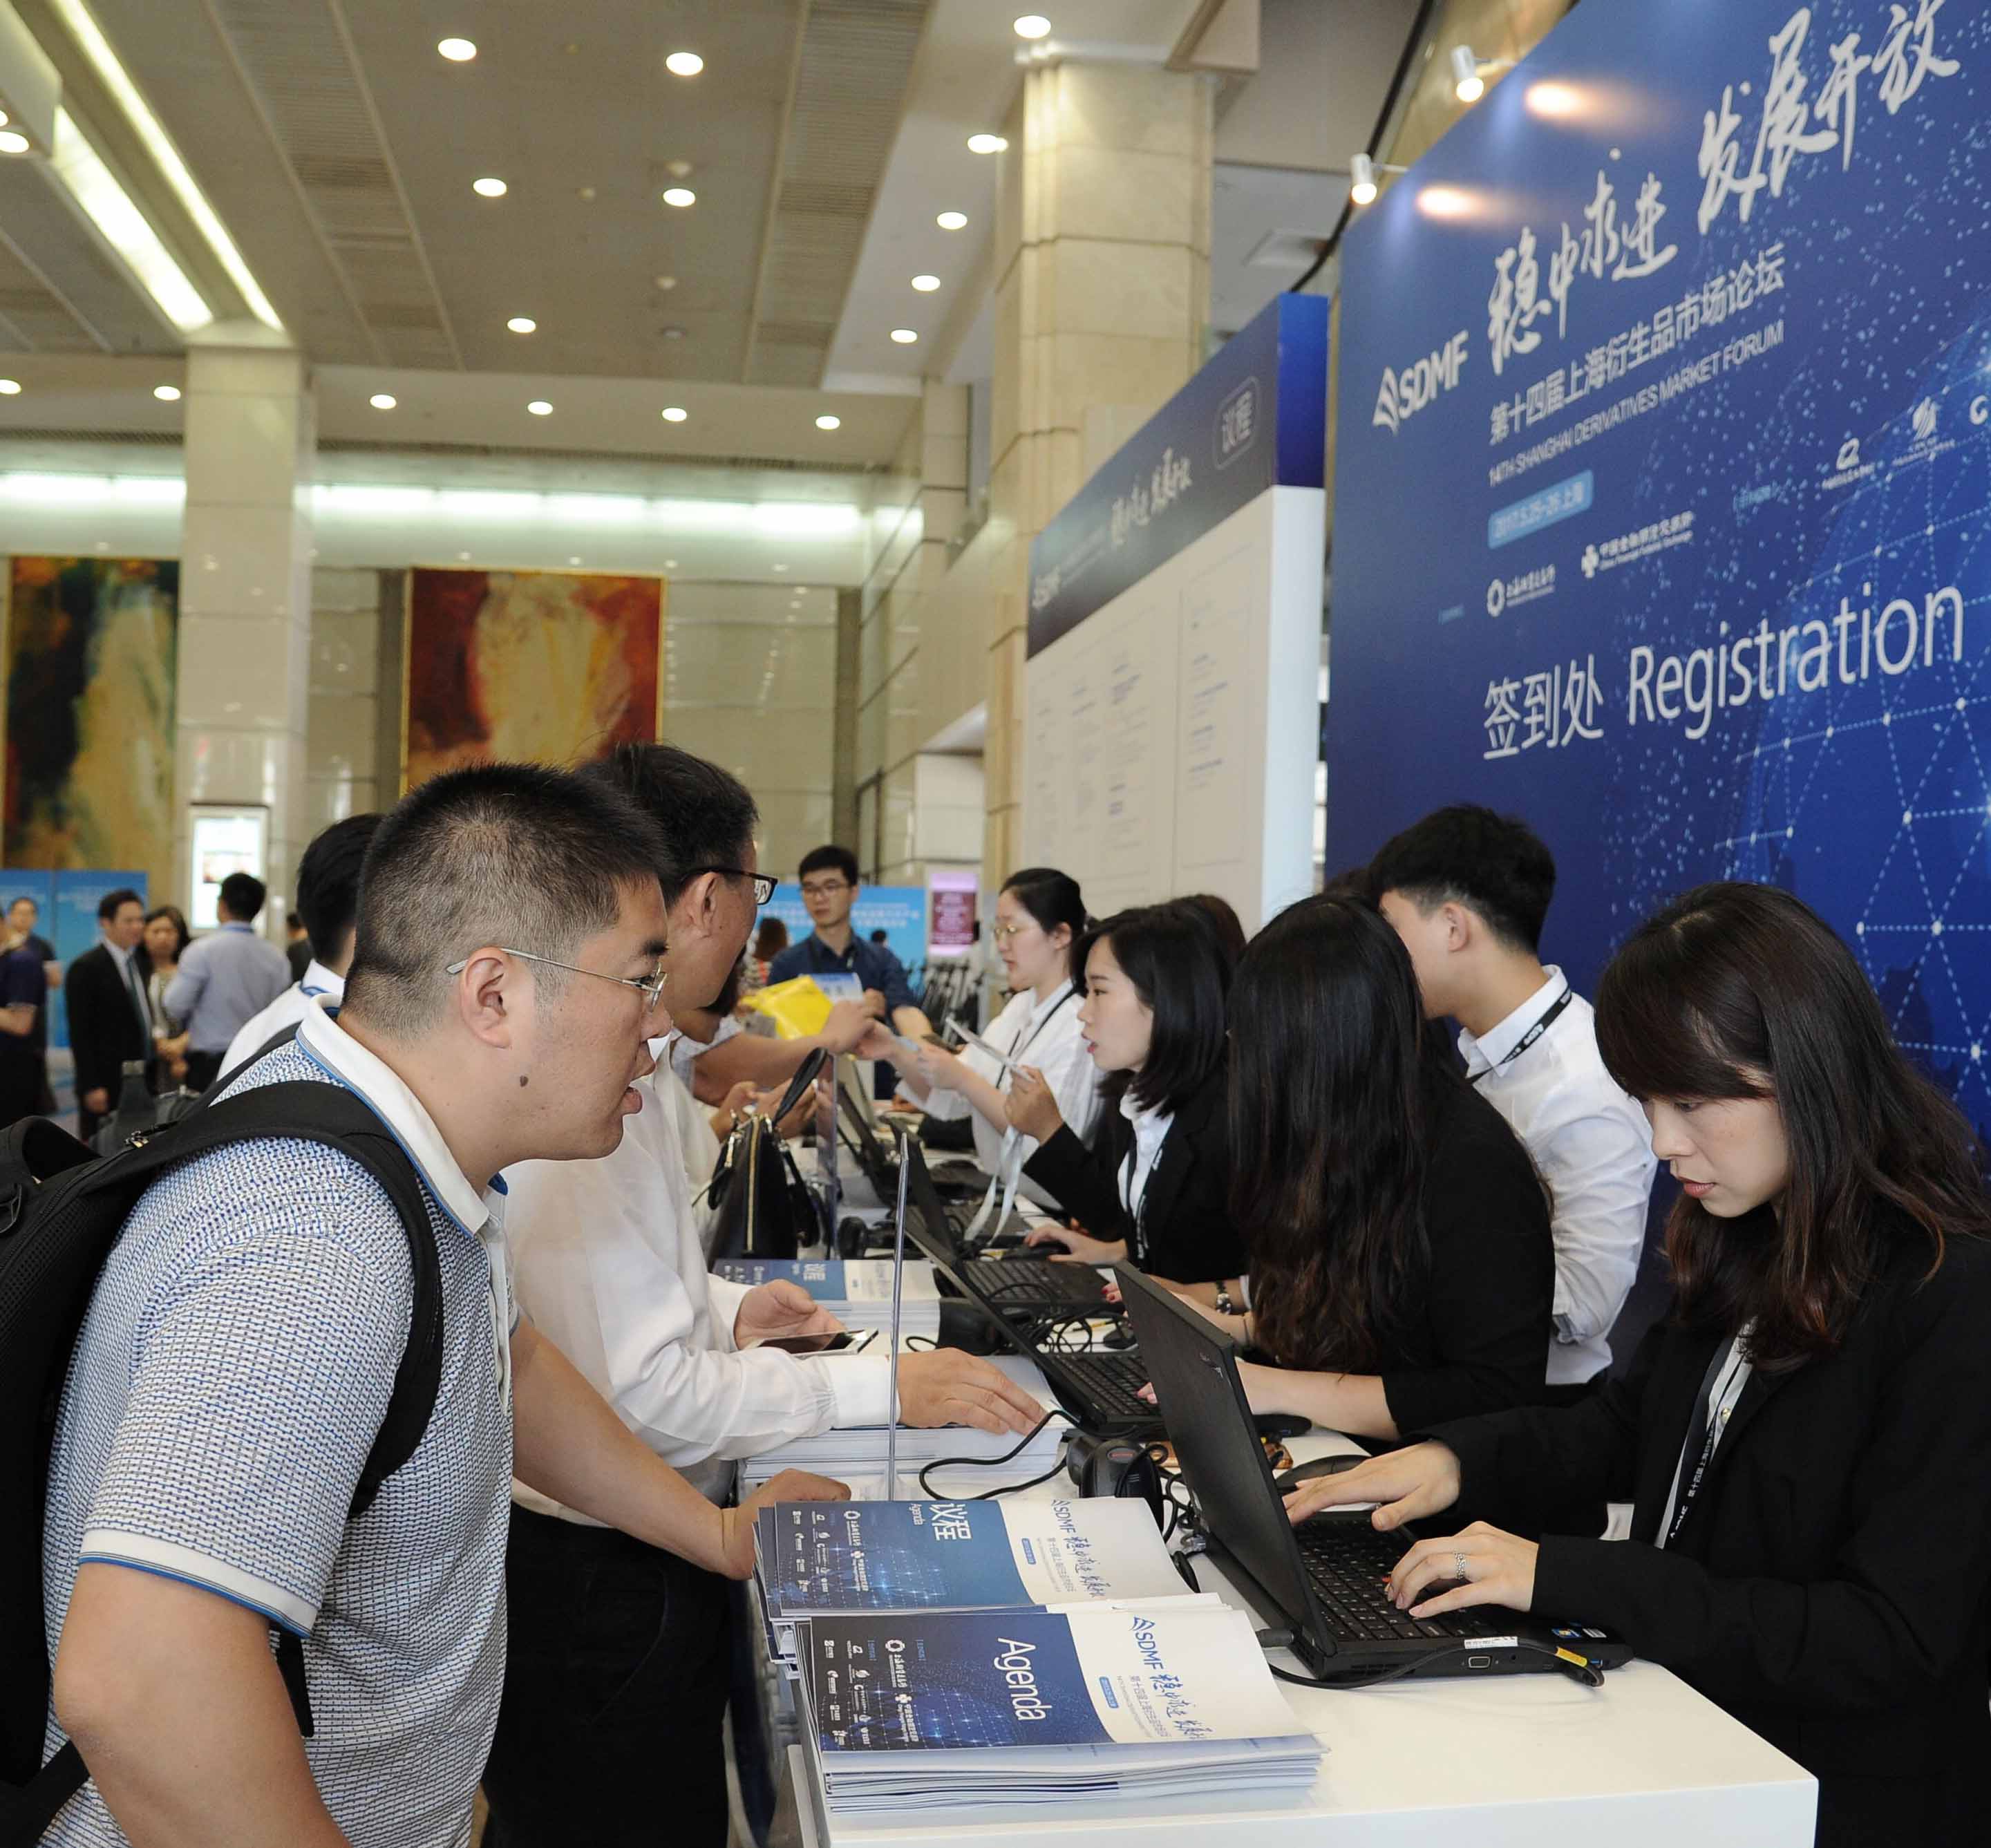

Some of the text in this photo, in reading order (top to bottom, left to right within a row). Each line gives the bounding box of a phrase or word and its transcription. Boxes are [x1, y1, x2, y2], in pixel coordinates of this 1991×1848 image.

[1399, 330, 1469, 422] SDMF
[1489, 242, 1786, 446] 第十四届上海衍生品市场论坛
[1515, 426, 1573, 475] SHANGHAI
[1574, 382, 1659, 446] DERIVATIVES
[1659, 350, 1721, 401] MARKET
[1723, 319, 1785, 367] FORUM
[1483, 581, 1964, 760] 签到处 Registration
[929, 1502, 973, 1541] 议程
[1053, 1506, 1077, 1534] SDMF
[994, 1637, 1053, 1721] Agenda
[1135, 1632, 1164, 1670] SDMF
